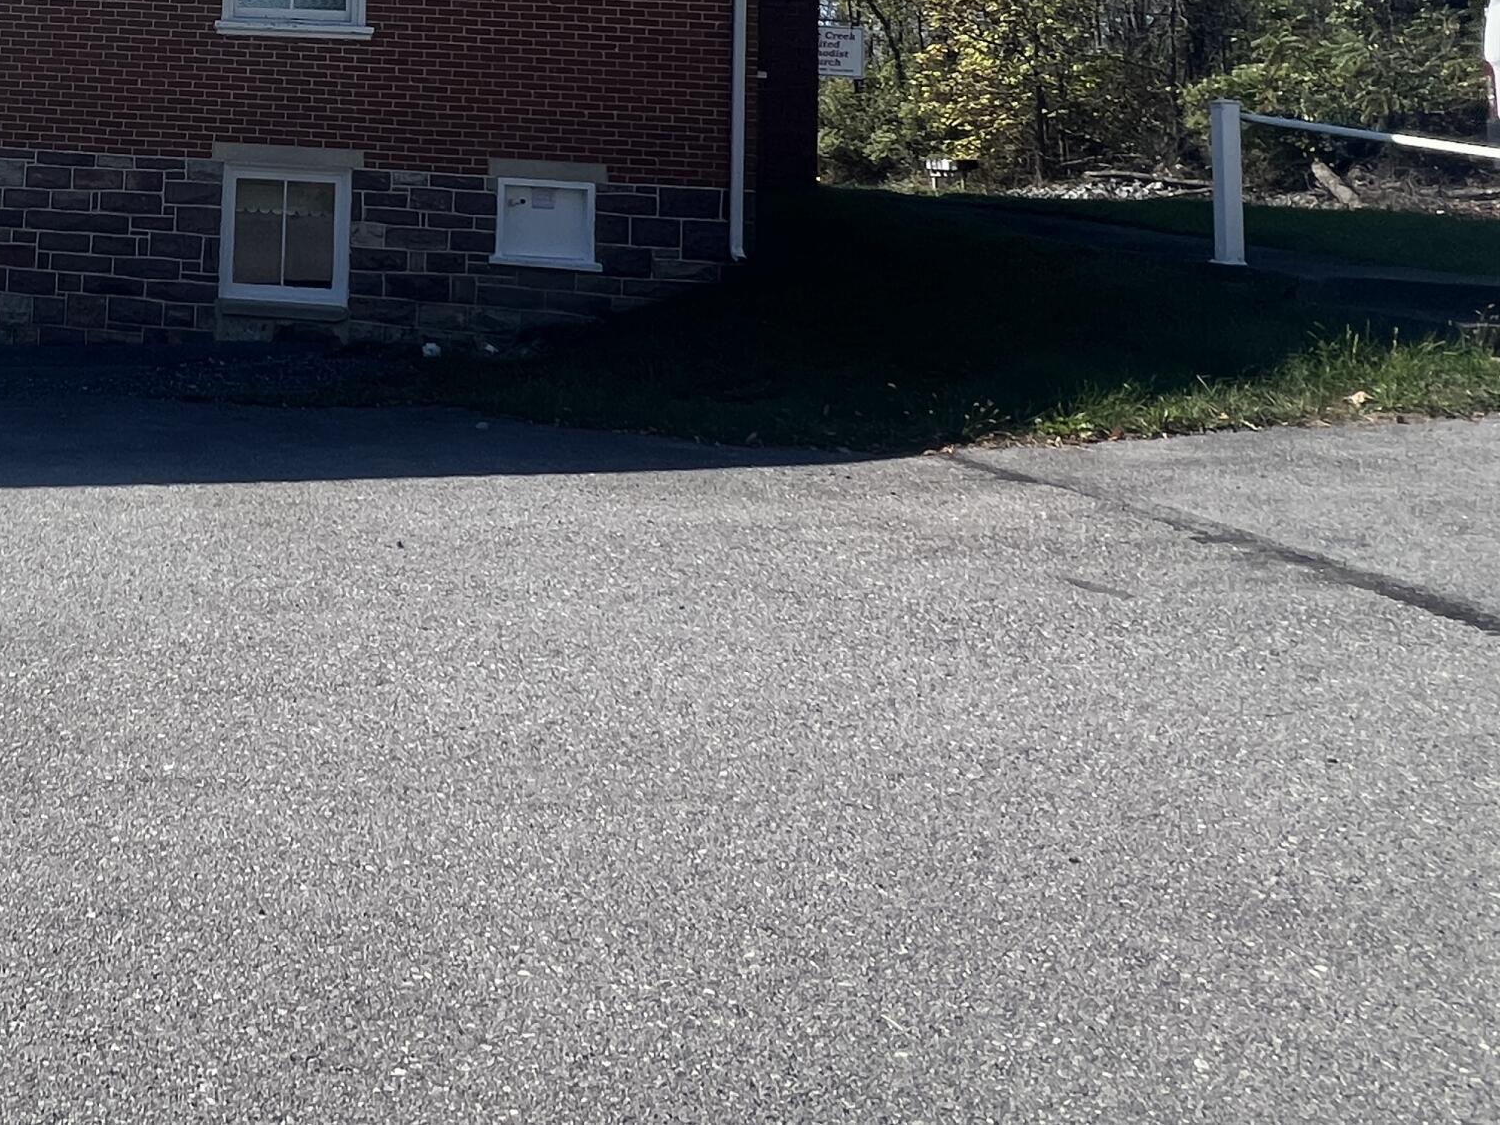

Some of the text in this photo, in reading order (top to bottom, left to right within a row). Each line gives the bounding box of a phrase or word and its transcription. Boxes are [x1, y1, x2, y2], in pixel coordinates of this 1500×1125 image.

[825, 31, 856, 41] Creek
[818, 40, 840, 49] ited
[818, 58, 841, 67] urch
